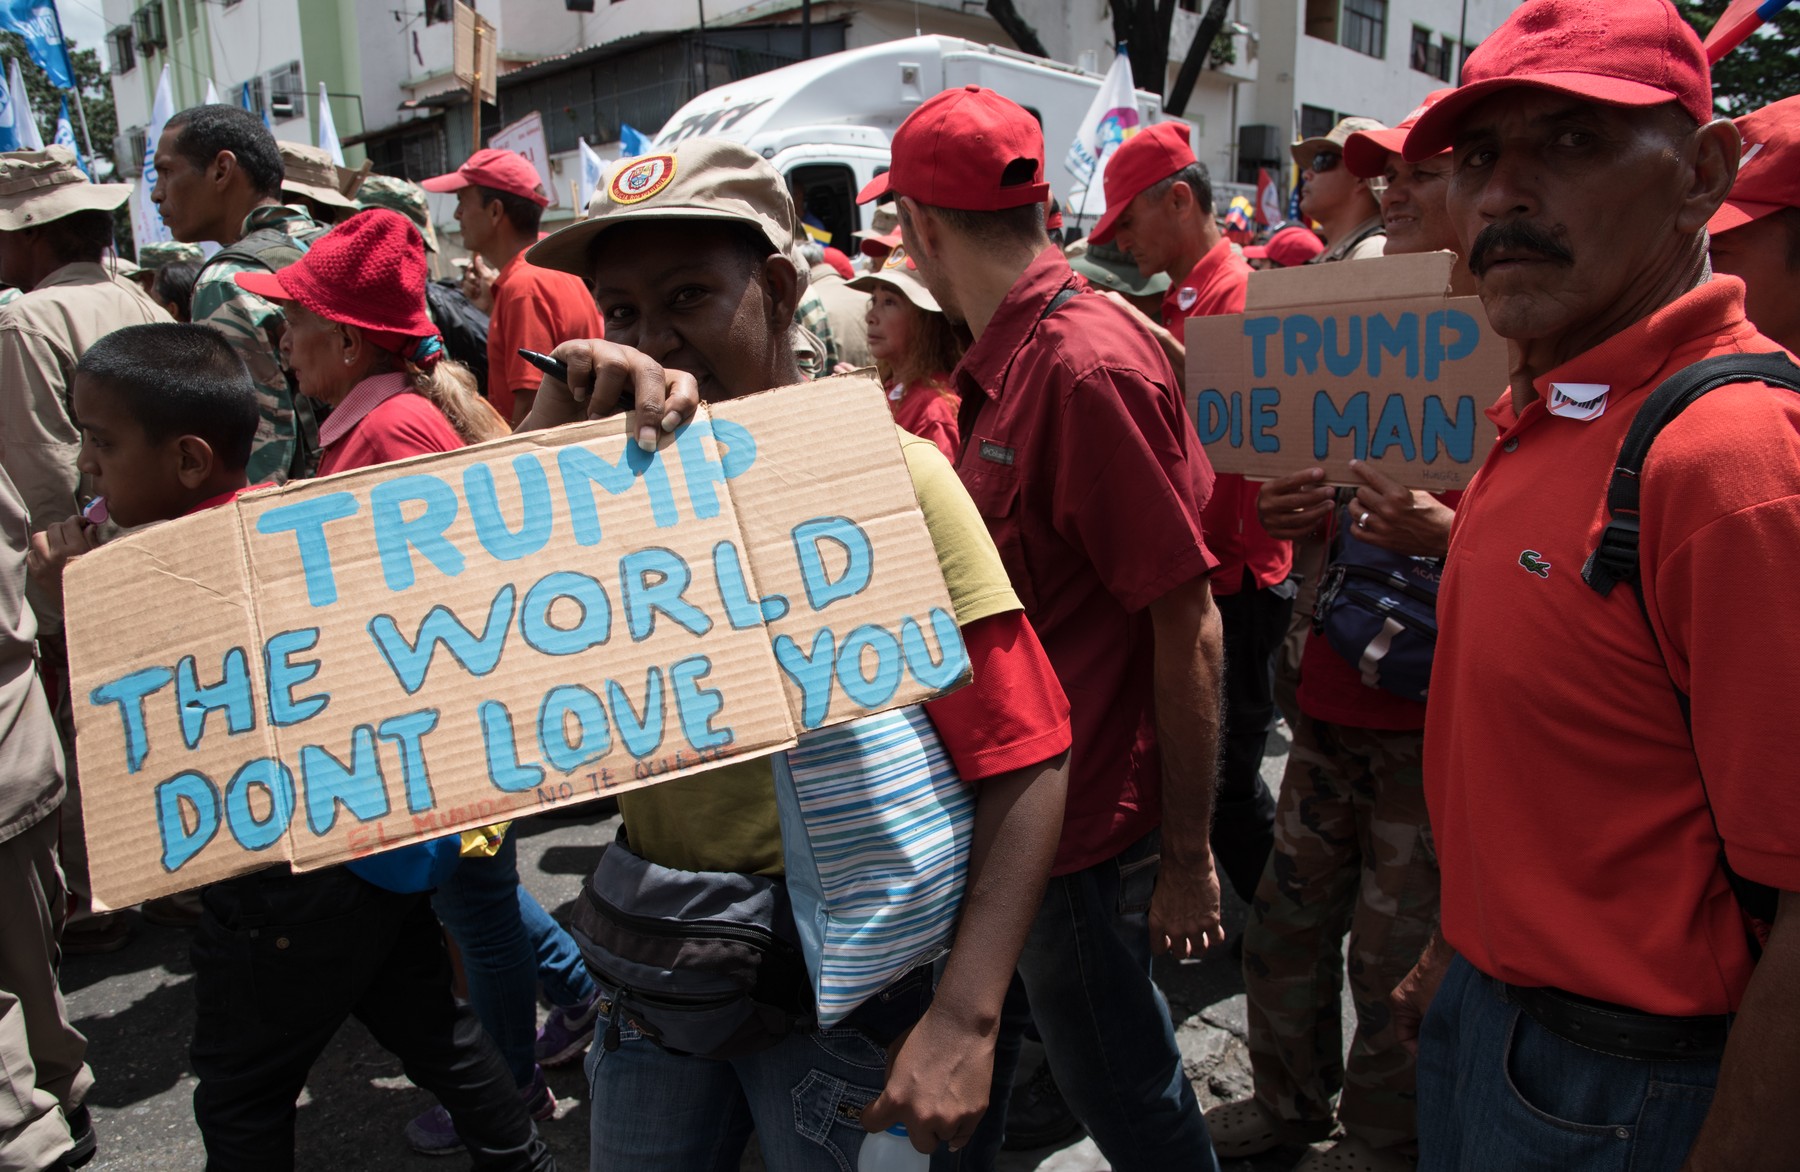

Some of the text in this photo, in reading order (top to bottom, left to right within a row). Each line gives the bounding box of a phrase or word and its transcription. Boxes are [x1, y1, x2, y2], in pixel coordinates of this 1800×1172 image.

[1243, 308, 1480, 382] TRUMP
[1197, 387, 1477, 465] DIE MAN
[256, 417, 757, 608] TRUMP
[90, 515, 875, 775] THE WORLD
[155, 605, 968, 873] DONT LOVE YOU
[346, 821, 401, 857] EL
[537, 781, 574, 806] NO
[586, 767, 619, 795] TE
